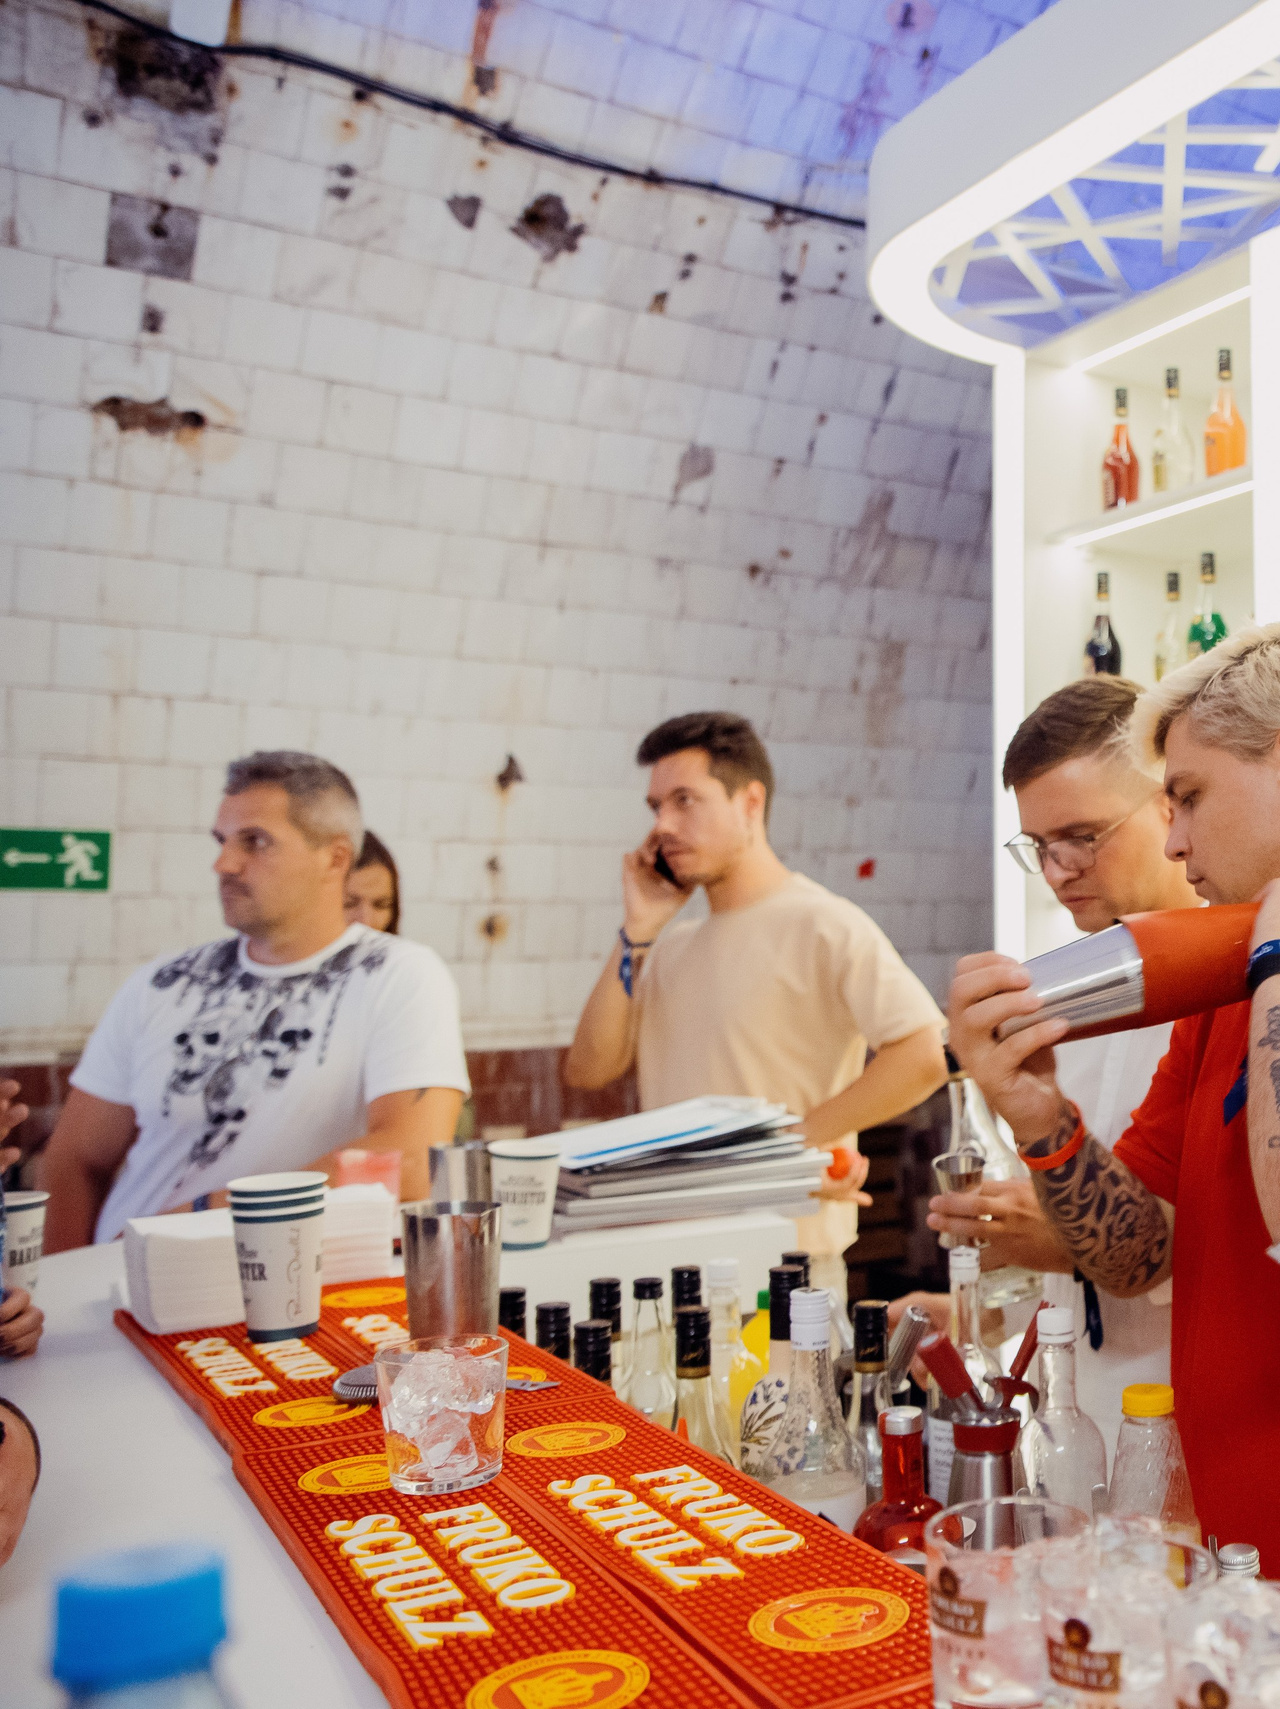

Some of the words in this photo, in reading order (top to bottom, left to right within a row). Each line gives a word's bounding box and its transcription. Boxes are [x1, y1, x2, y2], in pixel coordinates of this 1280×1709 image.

[239, 1261, 267, 1282] STER
[175, 1337, 279, 1398] SCHULZ
[243, 1337, 339, 1381] RUKO
[418, 1501, 577, 1611] FRUKO
[547, 1474, 745, 1592] SCHULZ
[629, 1464, 806, 1559] FRUKO
[324, 1513, 496, 1653] SCHULZ
